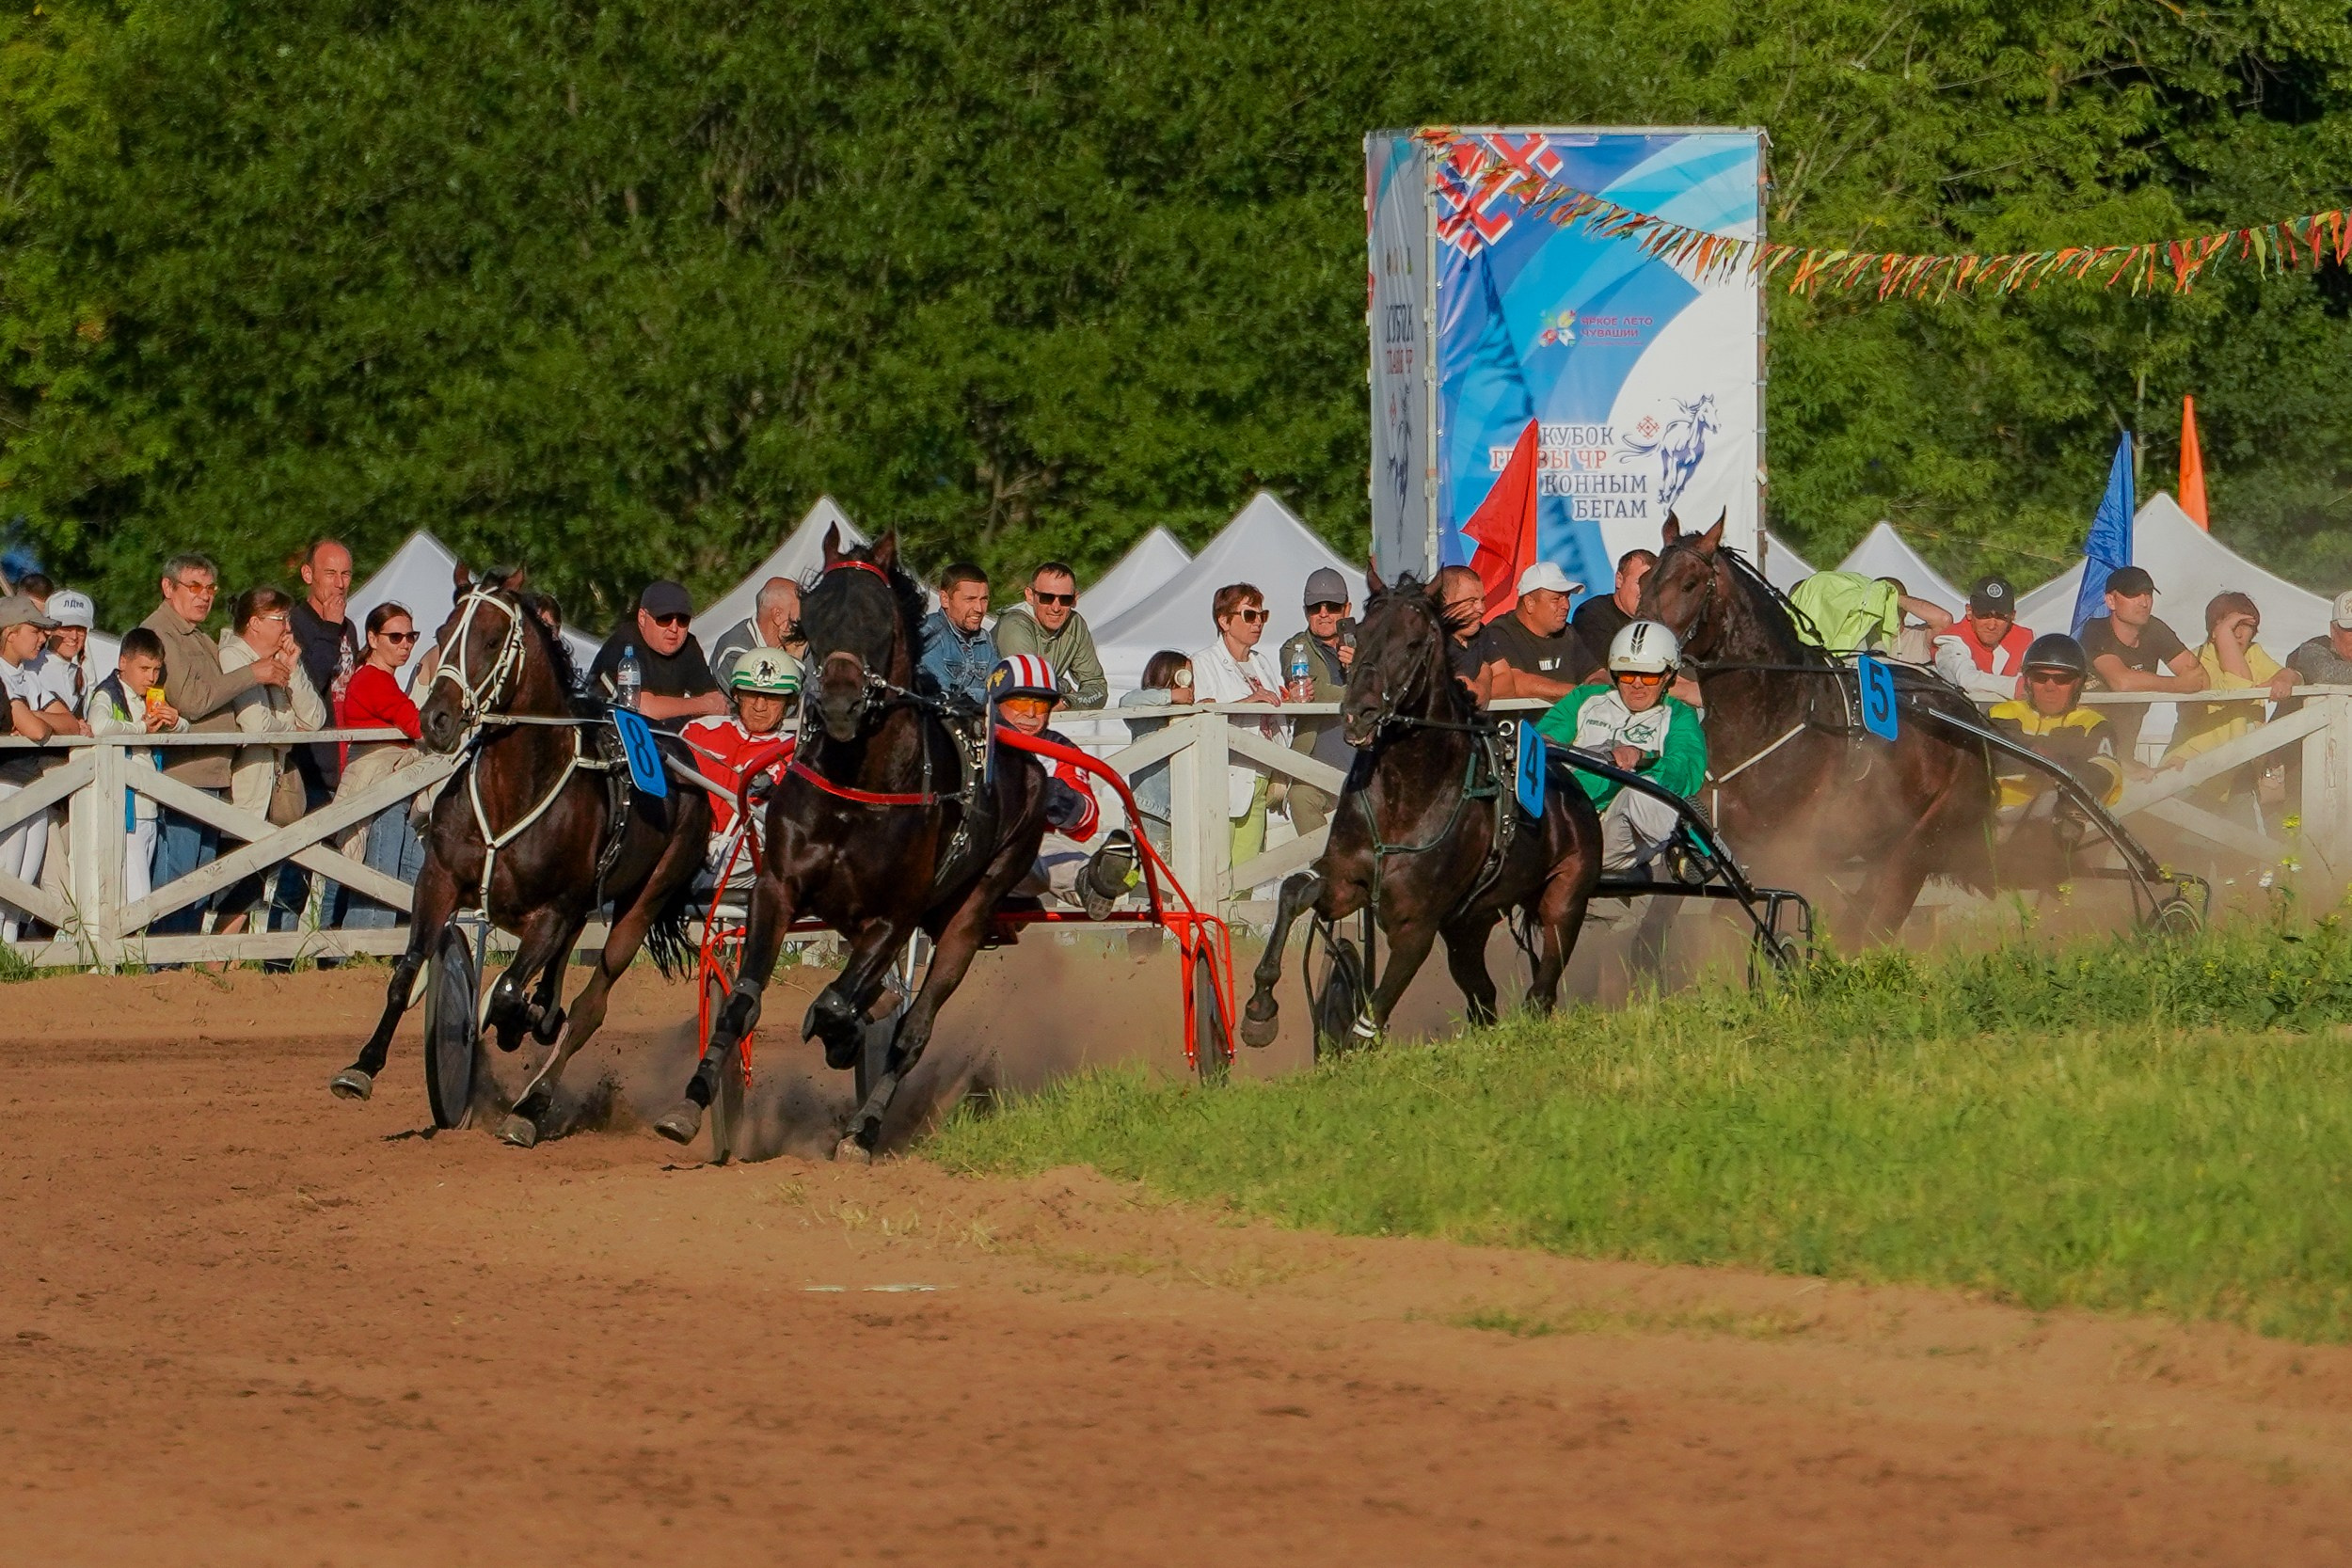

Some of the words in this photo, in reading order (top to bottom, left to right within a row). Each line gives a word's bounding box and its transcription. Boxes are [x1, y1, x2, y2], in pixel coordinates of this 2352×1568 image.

[1581, 317, 1617, 326] ЯРКОЕ
[1623, 317, 1653, 325] ЛЕТО
[1581, 328, 1639, 338] ЧУВАШИИ
[1541, 426, 1614, 445] КУБОК
[1492, 450, 1570, 469] ГВЫ
[1578, 450, 1607, 469] ЧР
[1544, 474, 1647, 494] КОННЫМ
[1575, 499, 1647, 518] БЕГАМ
[1869, 661, 1889, 722] 5
[626, 718, 654, 778] 8
[1525, 735, 1538, 797] 4
